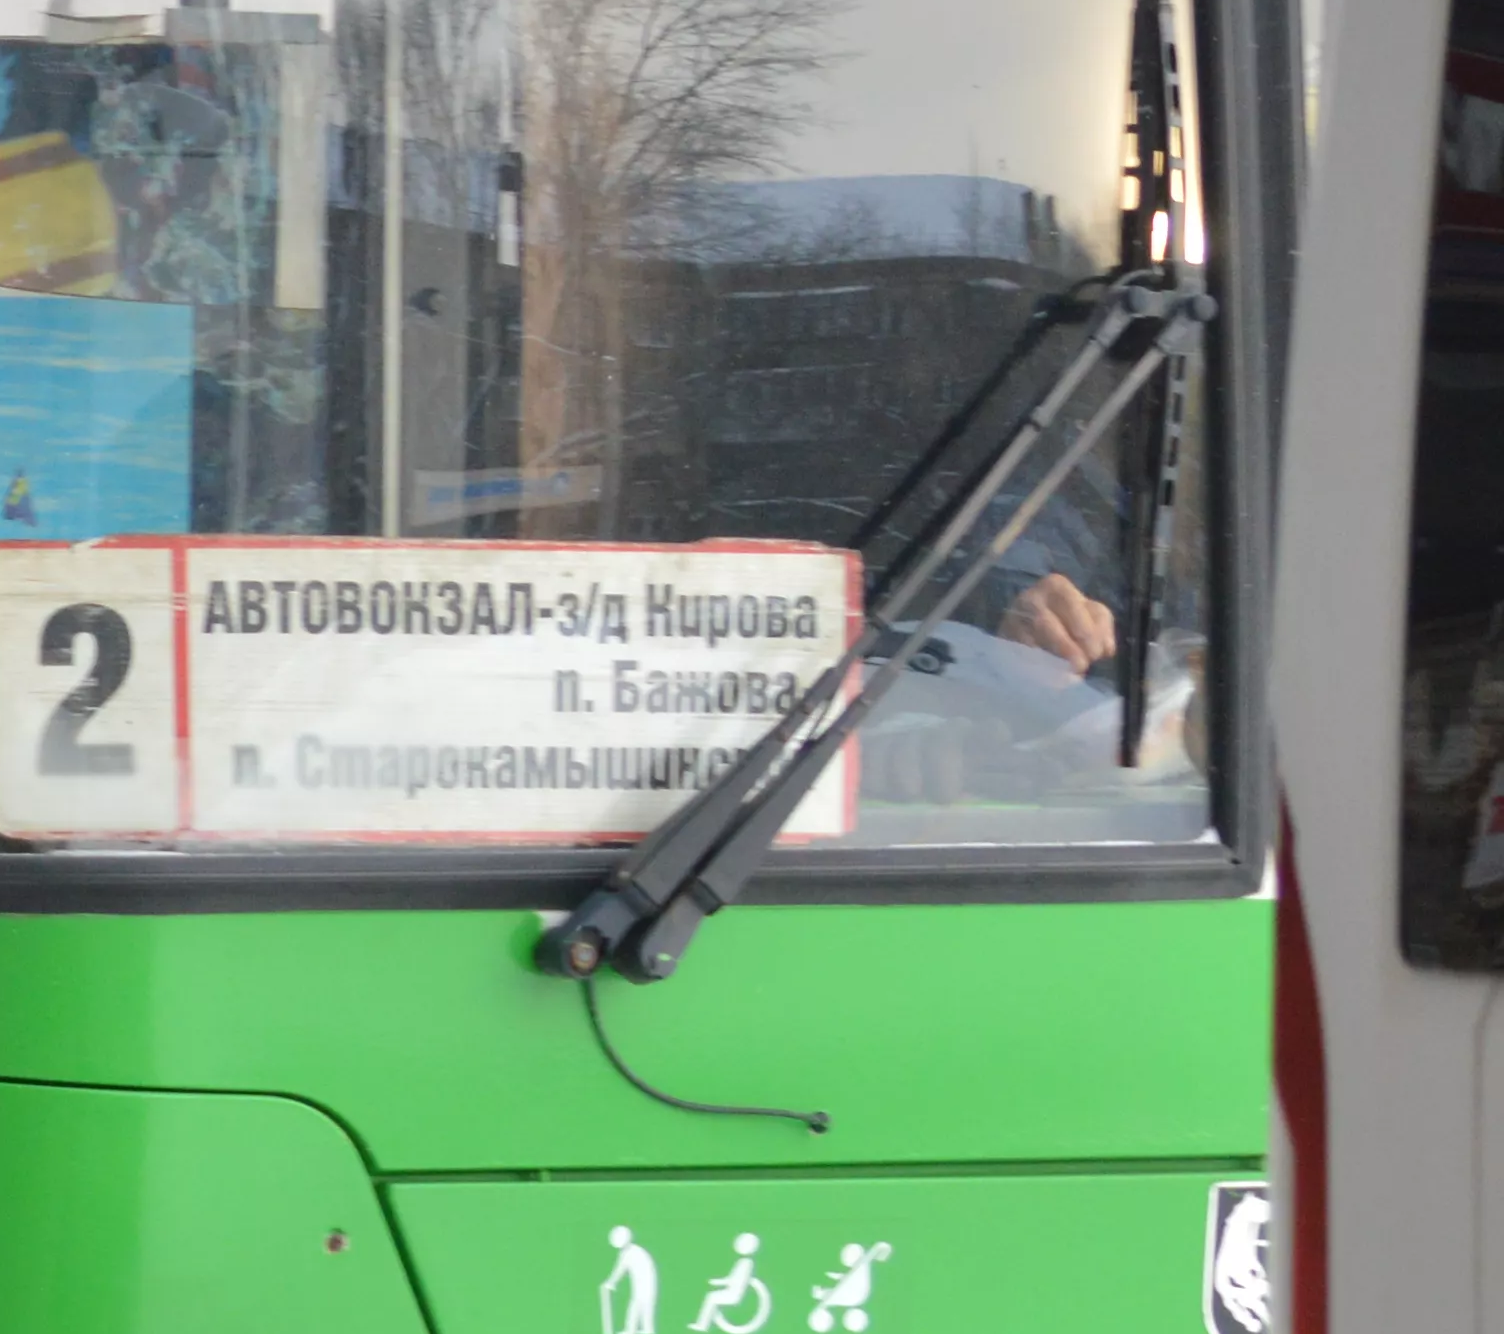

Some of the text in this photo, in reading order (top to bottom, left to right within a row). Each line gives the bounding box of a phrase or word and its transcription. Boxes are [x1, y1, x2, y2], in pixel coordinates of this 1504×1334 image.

[646, 583, 819, 647] Кирова
[39, 602, 136, 776] 2
[554, 669, 595, 714] п.
[232, 733, 749, 798] п. Старокамышинс
